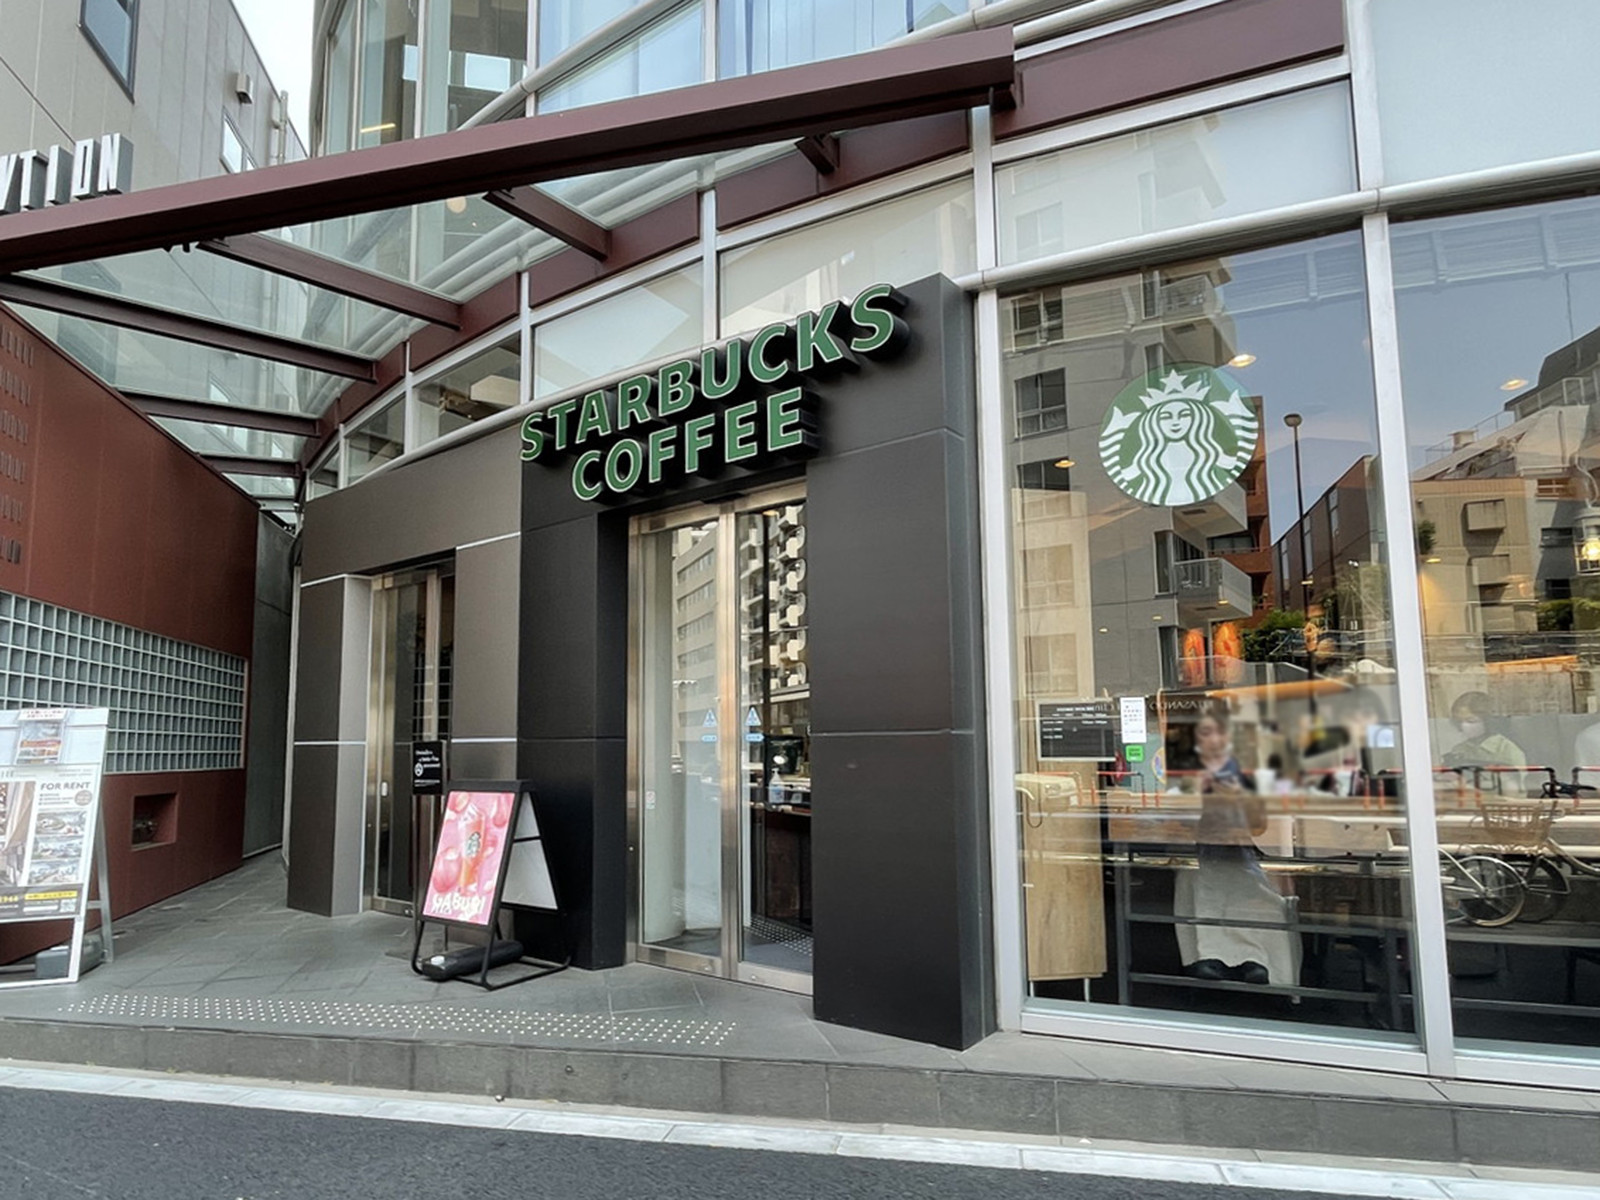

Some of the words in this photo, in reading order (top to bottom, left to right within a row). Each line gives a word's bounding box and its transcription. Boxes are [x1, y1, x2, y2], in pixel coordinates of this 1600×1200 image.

[520, 283, 895, 461] STARBUCKS
[571, 386, 802, 501] COFFEE
[63, 781, 91, 789] RENT
